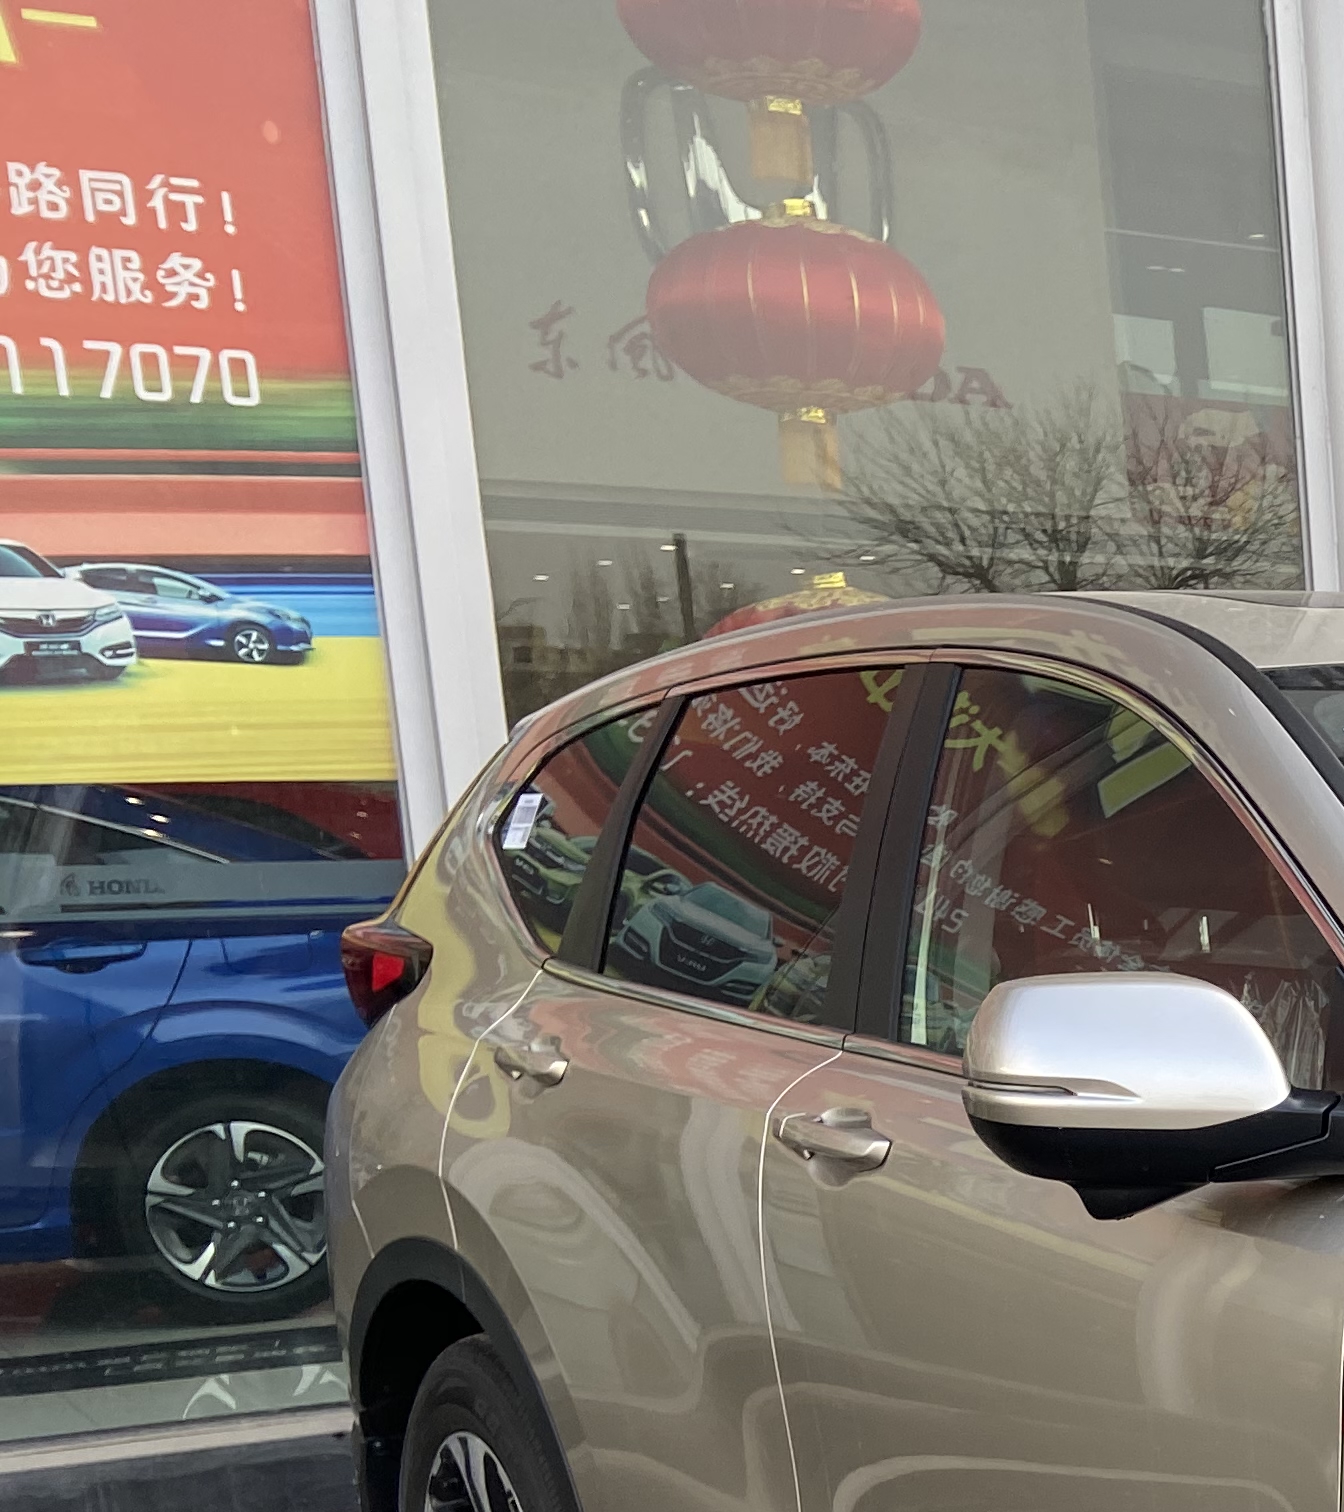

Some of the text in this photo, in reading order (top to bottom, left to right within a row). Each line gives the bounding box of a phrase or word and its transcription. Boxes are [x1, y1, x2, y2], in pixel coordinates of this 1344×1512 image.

[6, 161, 238, 235] 路同行！
[0, 241, 247, 313] 您服务！
